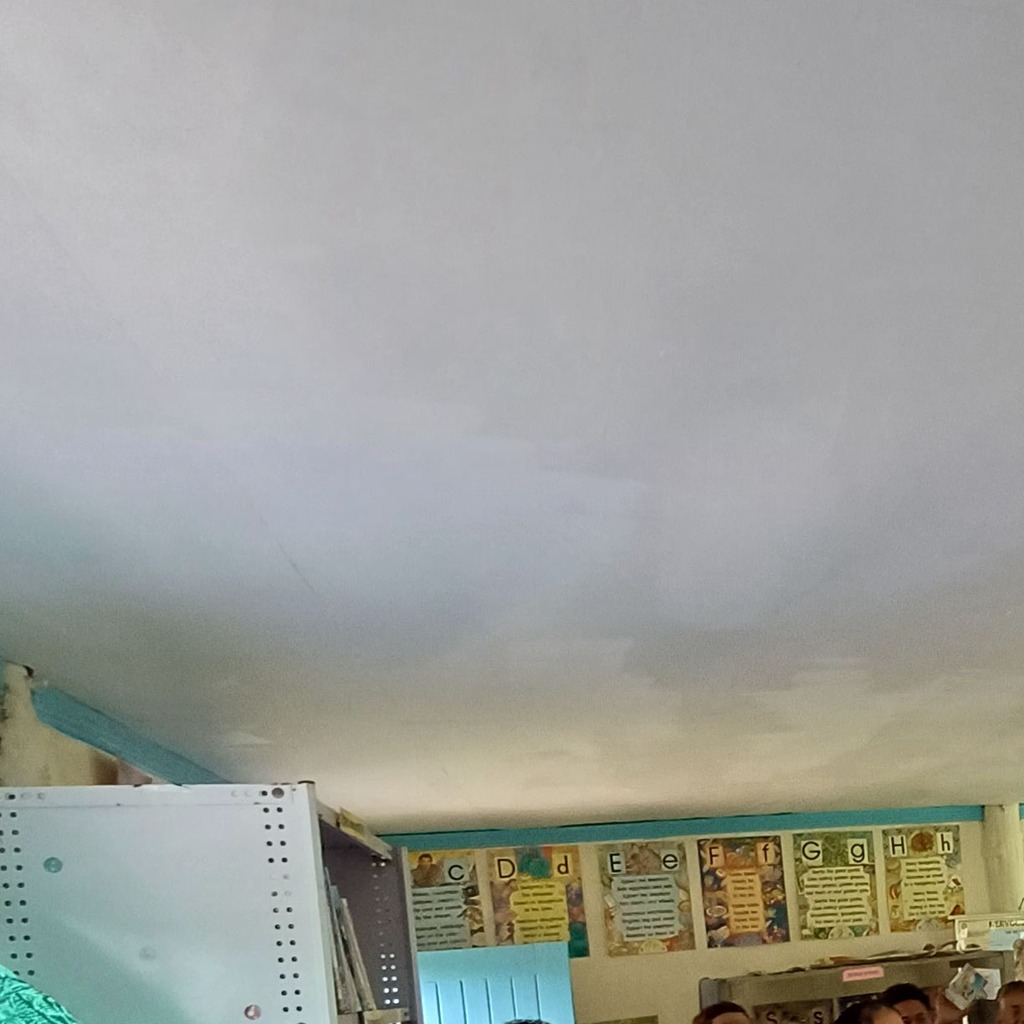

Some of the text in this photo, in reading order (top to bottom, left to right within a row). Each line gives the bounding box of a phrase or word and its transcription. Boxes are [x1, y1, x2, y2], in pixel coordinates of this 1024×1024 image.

[708, 846, 720, 865] F
[802, 841, 821, 861] G
[891, 836, 905, 856] H
[497, 858, 516, 879] D
[609, 853, 622, 873] E
